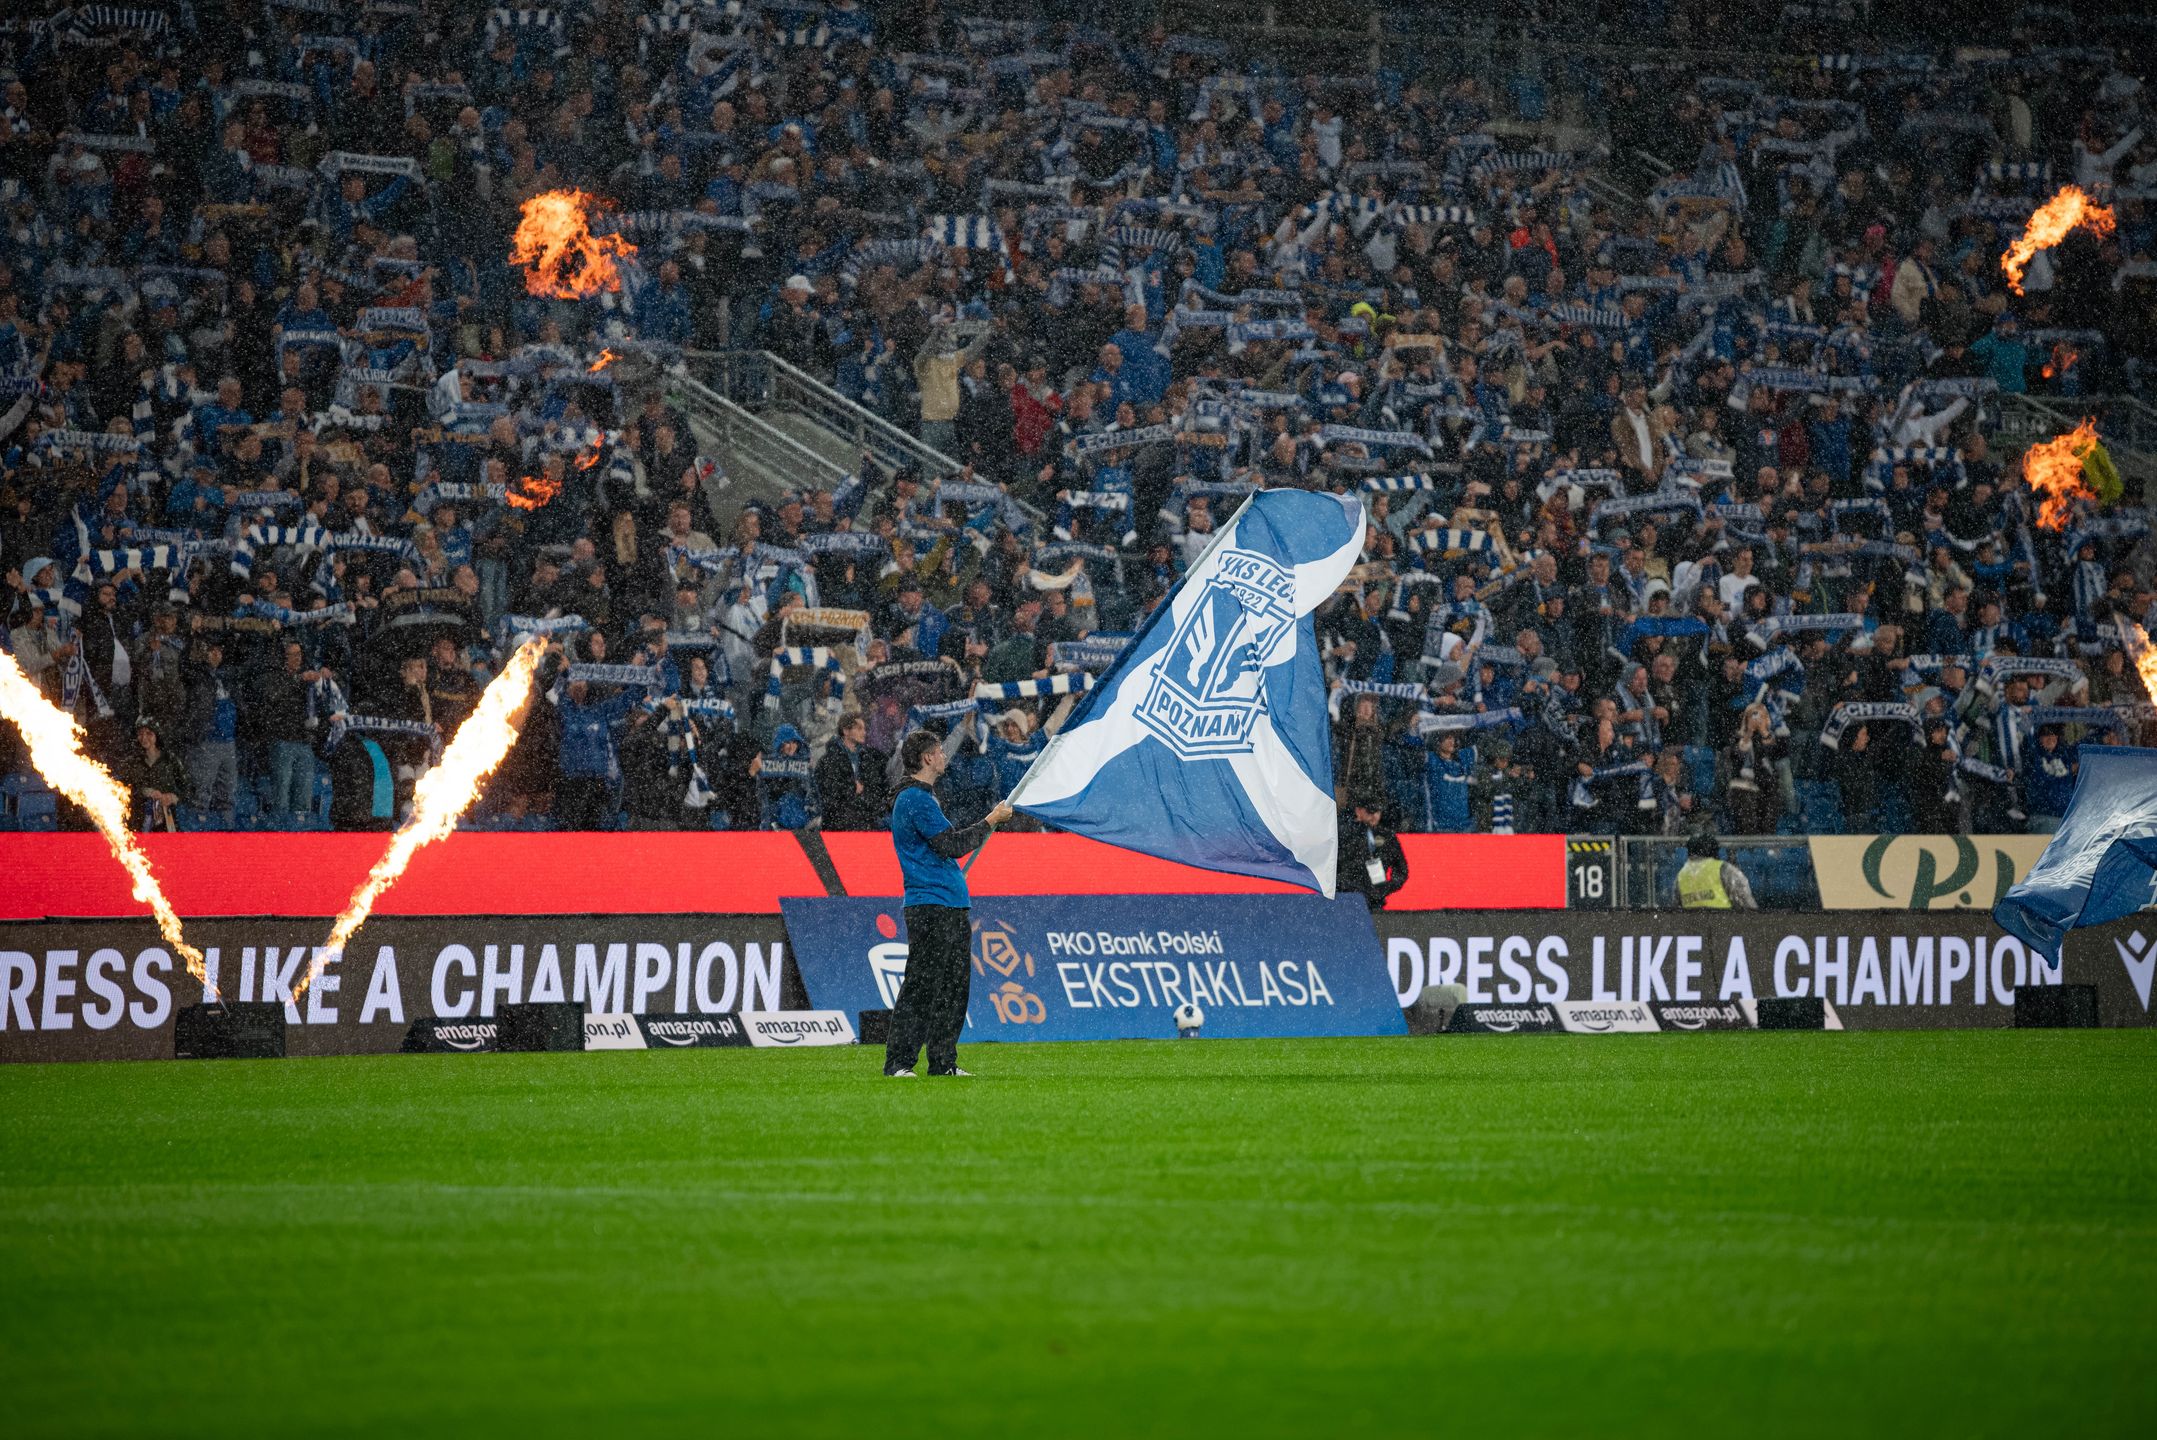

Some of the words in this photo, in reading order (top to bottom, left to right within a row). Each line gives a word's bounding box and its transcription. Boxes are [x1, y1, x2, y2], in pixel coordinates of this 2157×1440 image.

[1235, 587, 1263, 610] 922
[1255, 568, 1297, 604] LEC
[1156, 690, 1241, 738] POZNAŃ
[1574, 864, 1603, 899] 18
[1046, 931, 1097, 955] PKO
[1098, 931, 1158, 955] Bank
[1158, 929, 1223, 955] Polski
[1057, 960, 1334, 1008] EKSTRAKLASA
[1387, 935, 1569, 1009] DRESS
[1592, 935, 1702, 1002] LIKE
[1719, 935, 1754, 1000] A
[0, 948, 173, 1031] RESS
[202, 945, 344, 1025] LIKE
[359, 945, 404, 1024] A
[431, 941, 784, 1018] CHAMPION
[1473, 1006, 1554, 1026] amazon.pl
[1569, 1005, 1648, 1024] amazon.pl
[1661, 1004, 1742, 1022] amazon.pl
[647, 1017, 738, 1038] amazon.pl
[755, 1016, 844, 1037] amazon.pl
